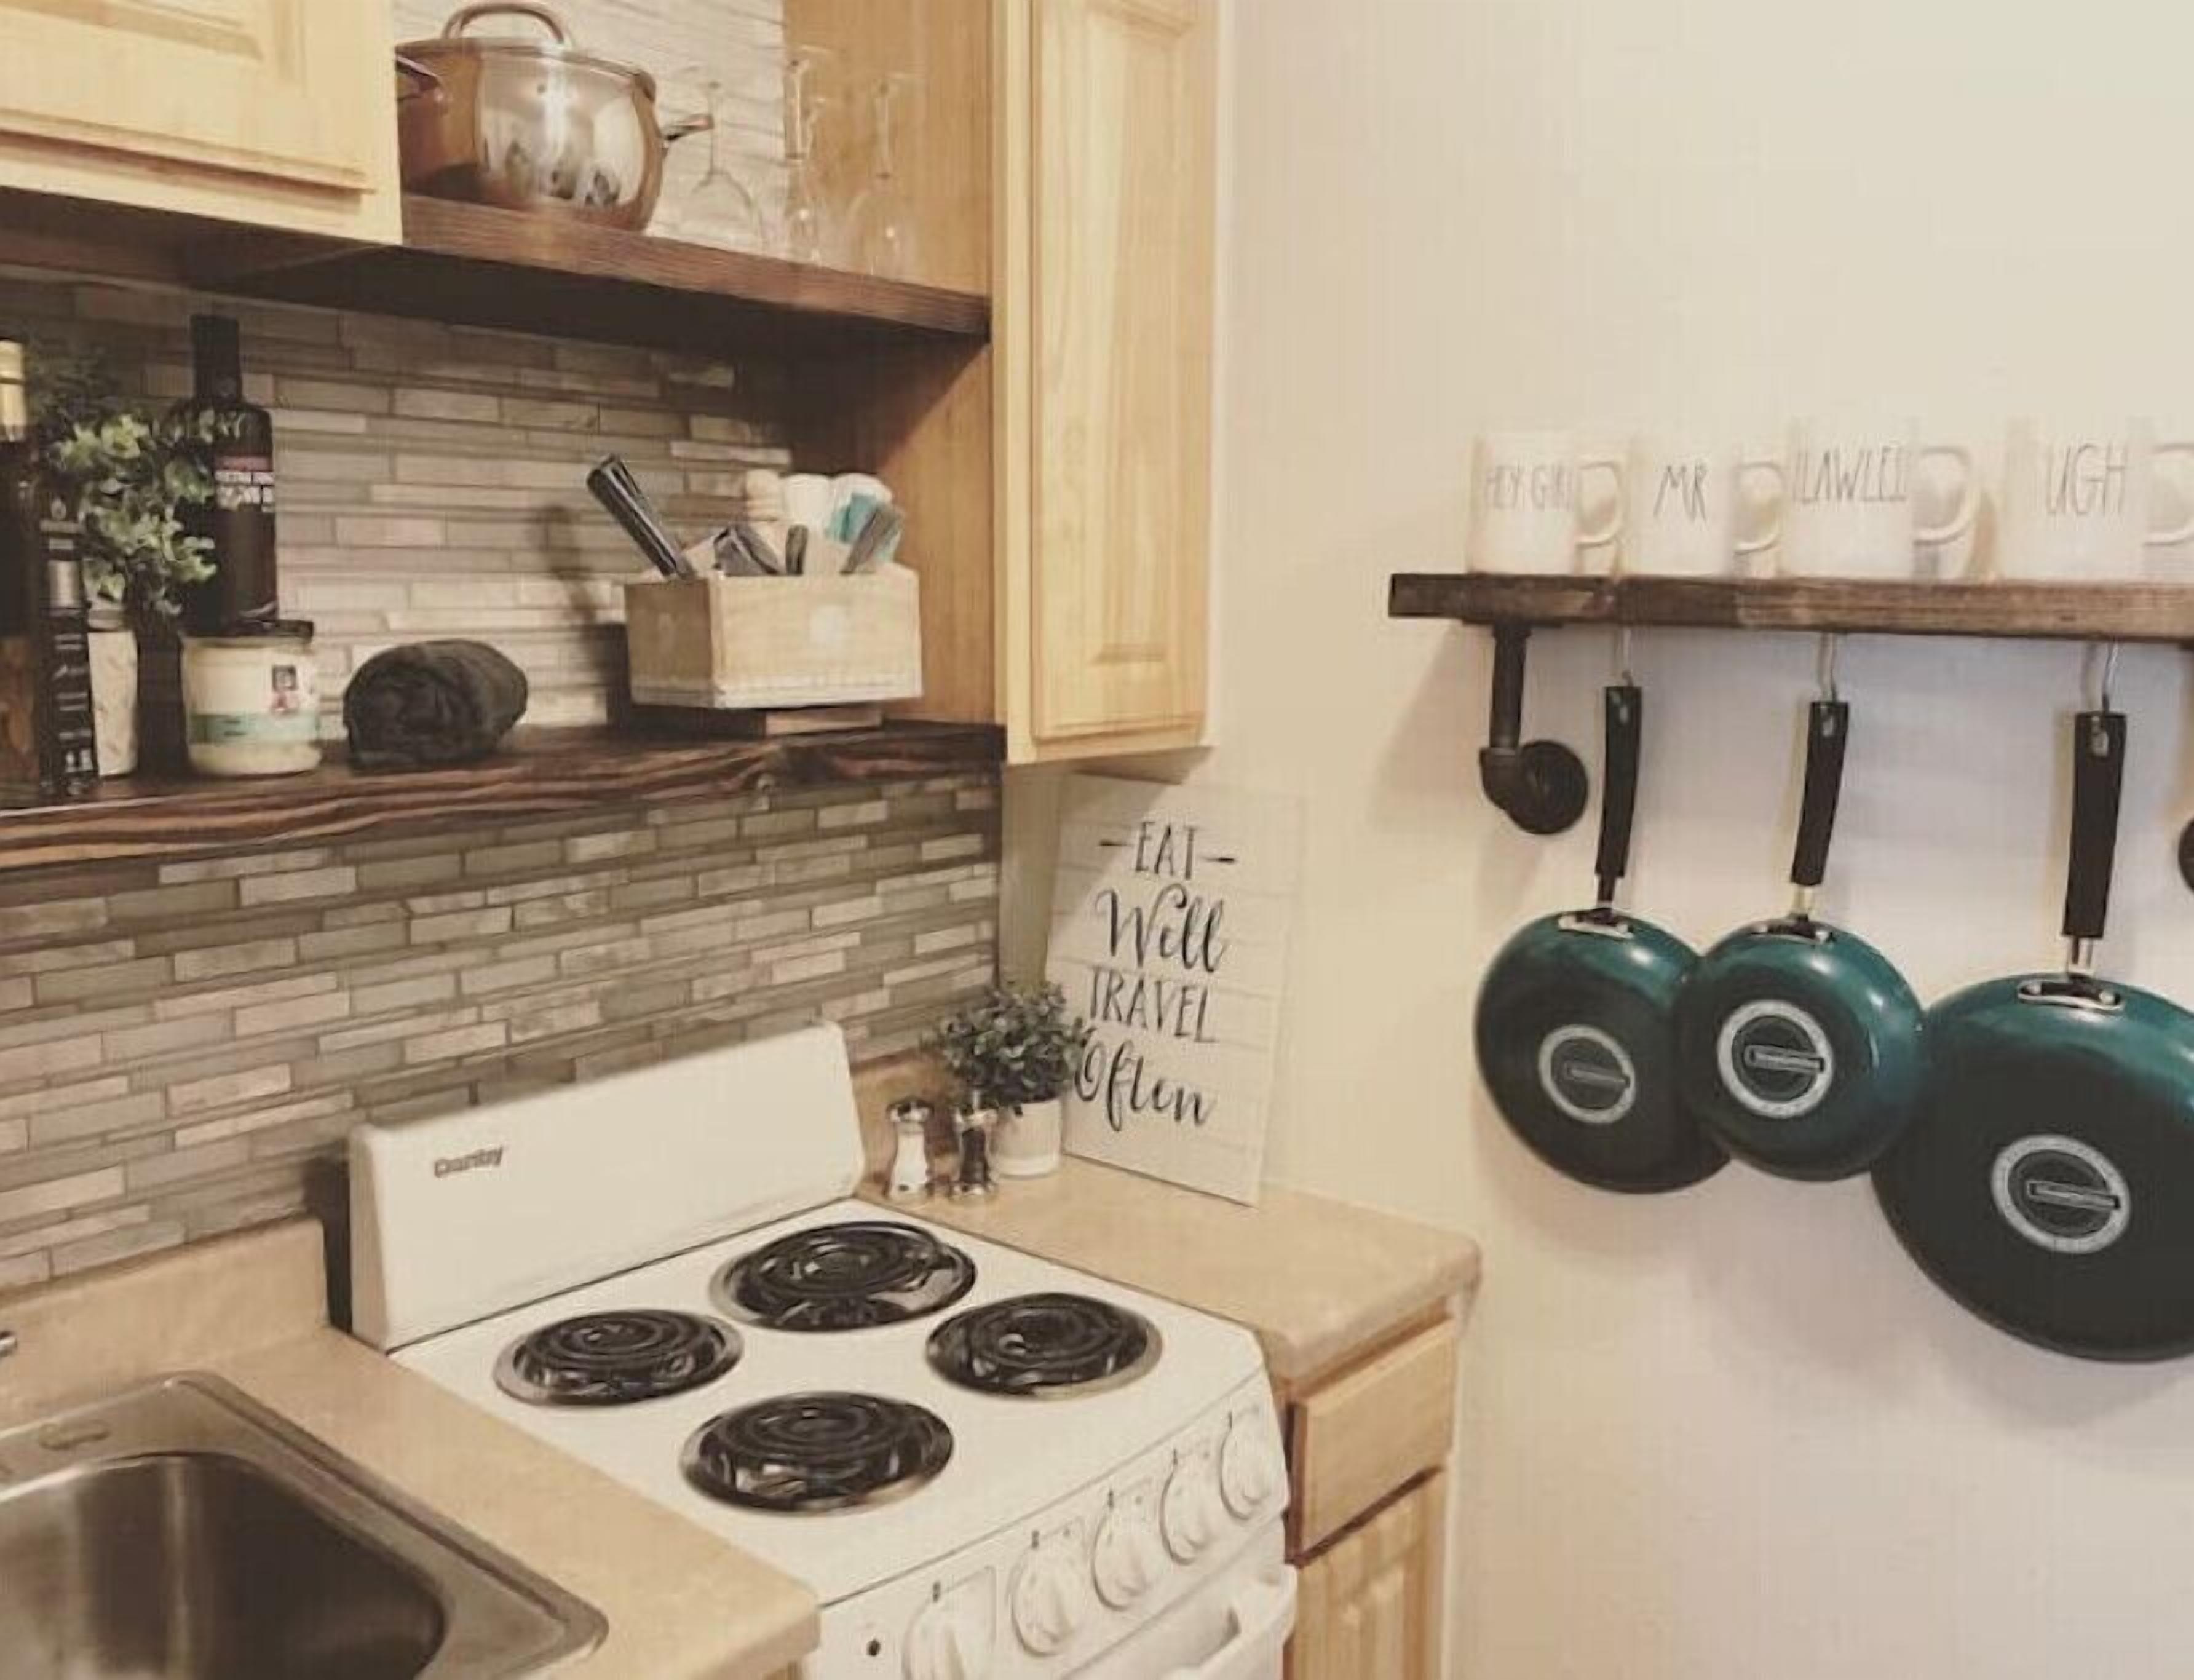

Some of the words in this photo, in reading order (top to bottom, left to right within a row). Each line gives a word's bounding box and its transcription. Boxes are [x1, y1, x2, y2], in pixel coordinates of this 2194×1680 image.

[1653, 461, 1708, 523] MR
[2046, 441, 2129, 517] UGH
[1135, 820, 1199, 881] EAT
[1095, 882, 1229, 973] Well
[1089, 965, 1218, 1044] TRAVEL
[1074, 1040, 1215, 1132] Often
